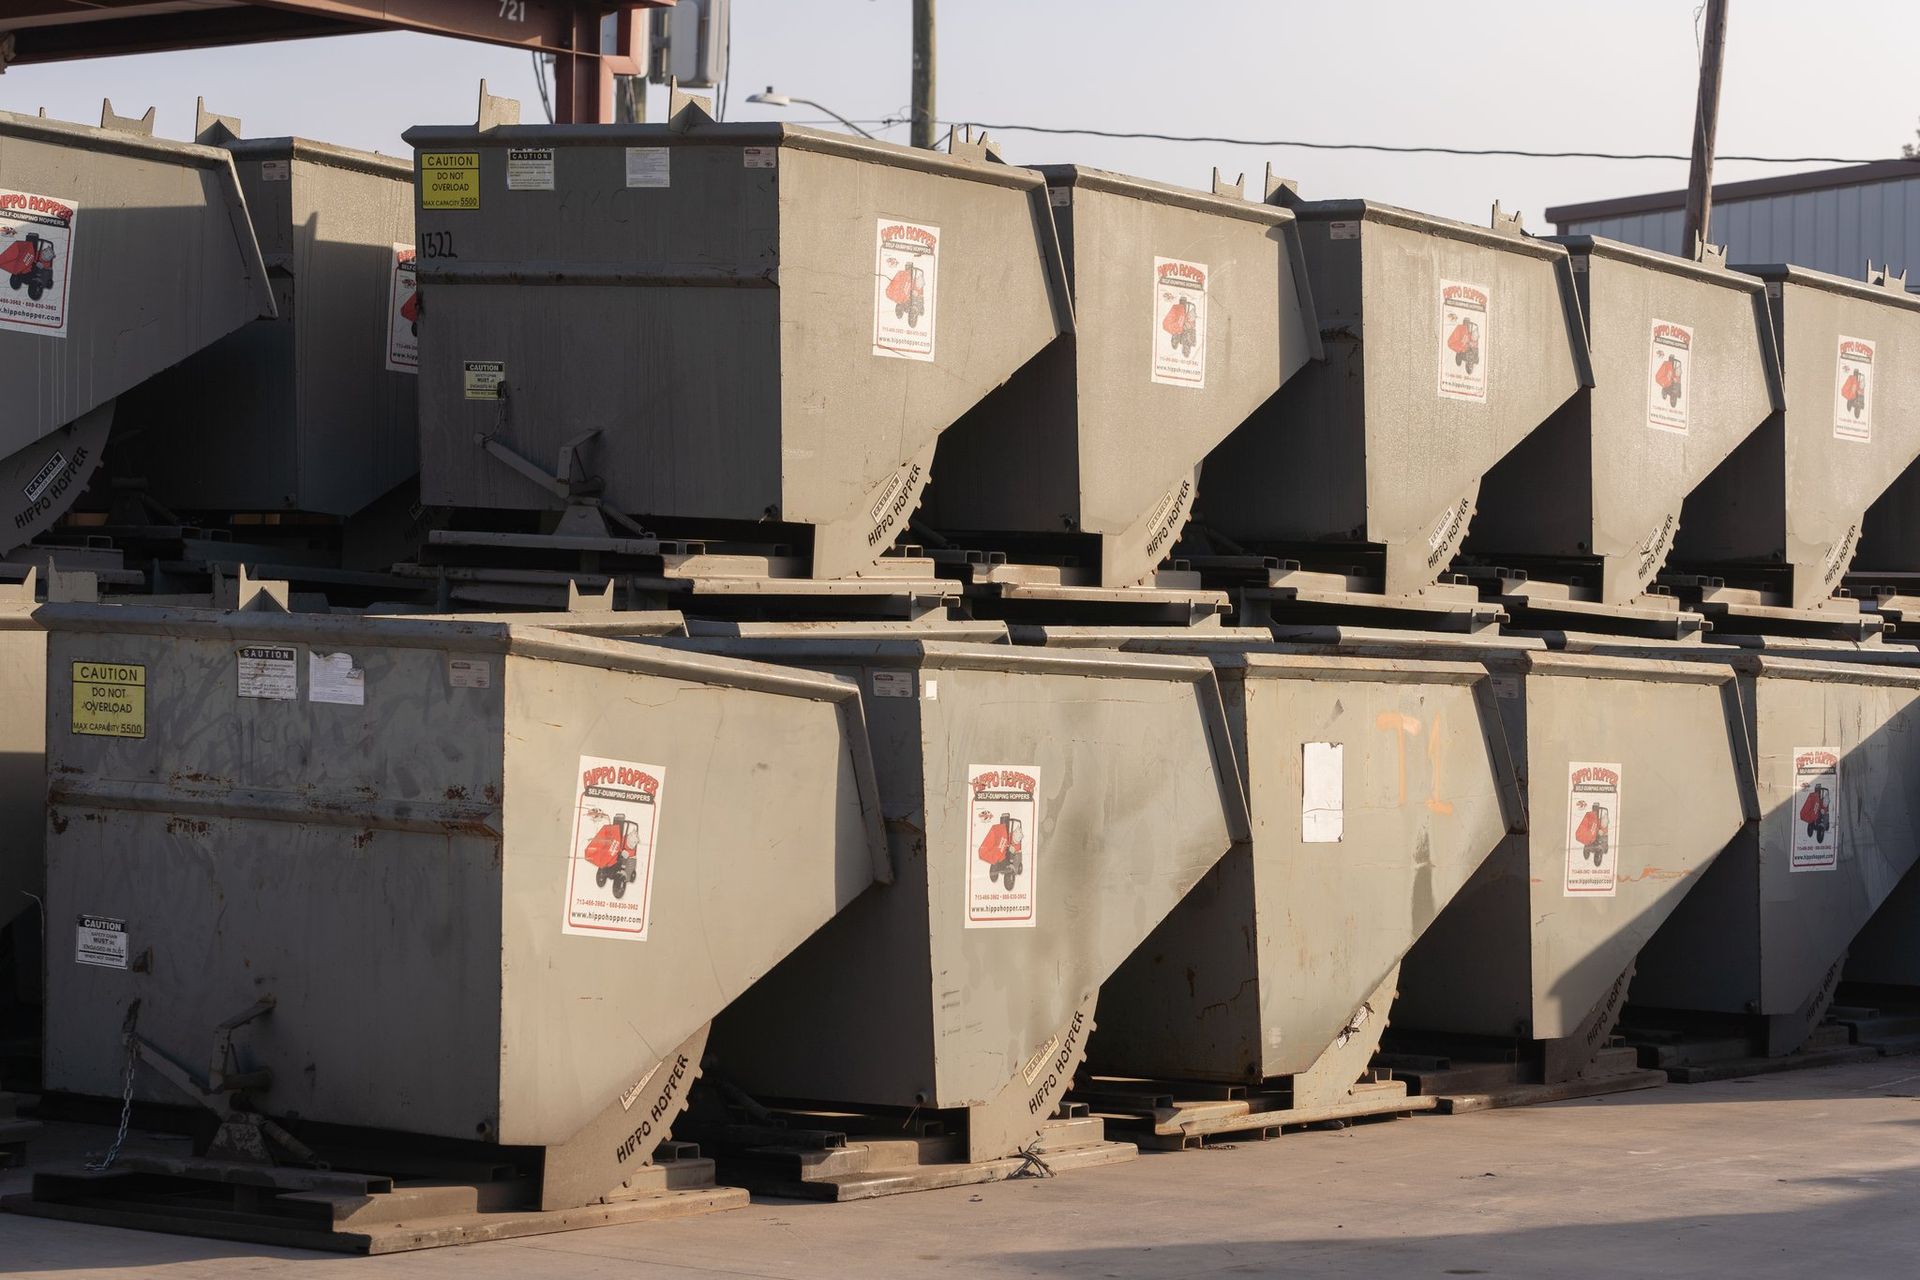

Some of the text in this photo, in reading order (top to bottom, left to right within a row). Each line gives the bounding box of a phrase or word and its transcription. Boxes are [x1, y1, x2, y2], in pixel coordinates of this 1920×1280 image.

[499, 0, 525, 22] 721
[428, 156, 473, 166] CAUTION
[512, 152, 548, 160] CAUTION
[437, 172, 464, 180] DO NOT
[432, 183, 469, 191] OVERLOAD
[0, 195, 73, 224] IPPO HOPPER
[38, 217, 65, 226] HOPPERS
[422, 231, 458, 258] 1322
[880, 225, 937, 249] HIPPO HOPPER
[1157, 263, 1178, 277] HIPPO
[28, 459, 59, 492] CAUTION
[15, 497, 51, 529] HIPPO
[50, 446, 89, 499] HOPPER
[868, 514, 894, 546] HIPPO
[893, 464, 921, 516] HOPPER
[1146, 527, 1168, 557] HIPPO
[1167, 480, 1190, 528] HOPPER
[1427, 542, 1448, 569] HIPPO
[1447, 497, 1469, 542] HOPPER
[1638, 554, 1655, 580] HIPPO
[1655, 513, 1673, 556] HOPPER
[1824, 560, 1840, 585] HIPPO
[244, 649, 289, 659] CAUTION
[80, 666, 138, 681] CAUTION
[92, 687, 126, 698] DO NOT
[85, 701, 132, 713] OVERLOAD
[73, 722, 142, 734] MAX CAPACITY 5500
[583, 766, 659, 797] HIPPO HOPPER
[972, 769, 1036, 792] HIPPO HOPPER
[1571, 767, 1618, 785] HIPPO HOPPER
[588, 788, 650, 802] SELF-DUMPING HOPPERS
[571, 911, 642, 923] www.hippohopper.com
[971, 904, 1030, 914] www.hippohopper.com
[84, 919, 122, 931] CAUTION
[1586, 1012, 1608, 1046] HIPPO
[1029, 1074, 1057, 1114] HIPPO
[1055, 1010, 1084, 1074] HOPPER
[616, 1120, 651, 1164] HIPPO
[650, 1054, 689, 1122] HOPPER
